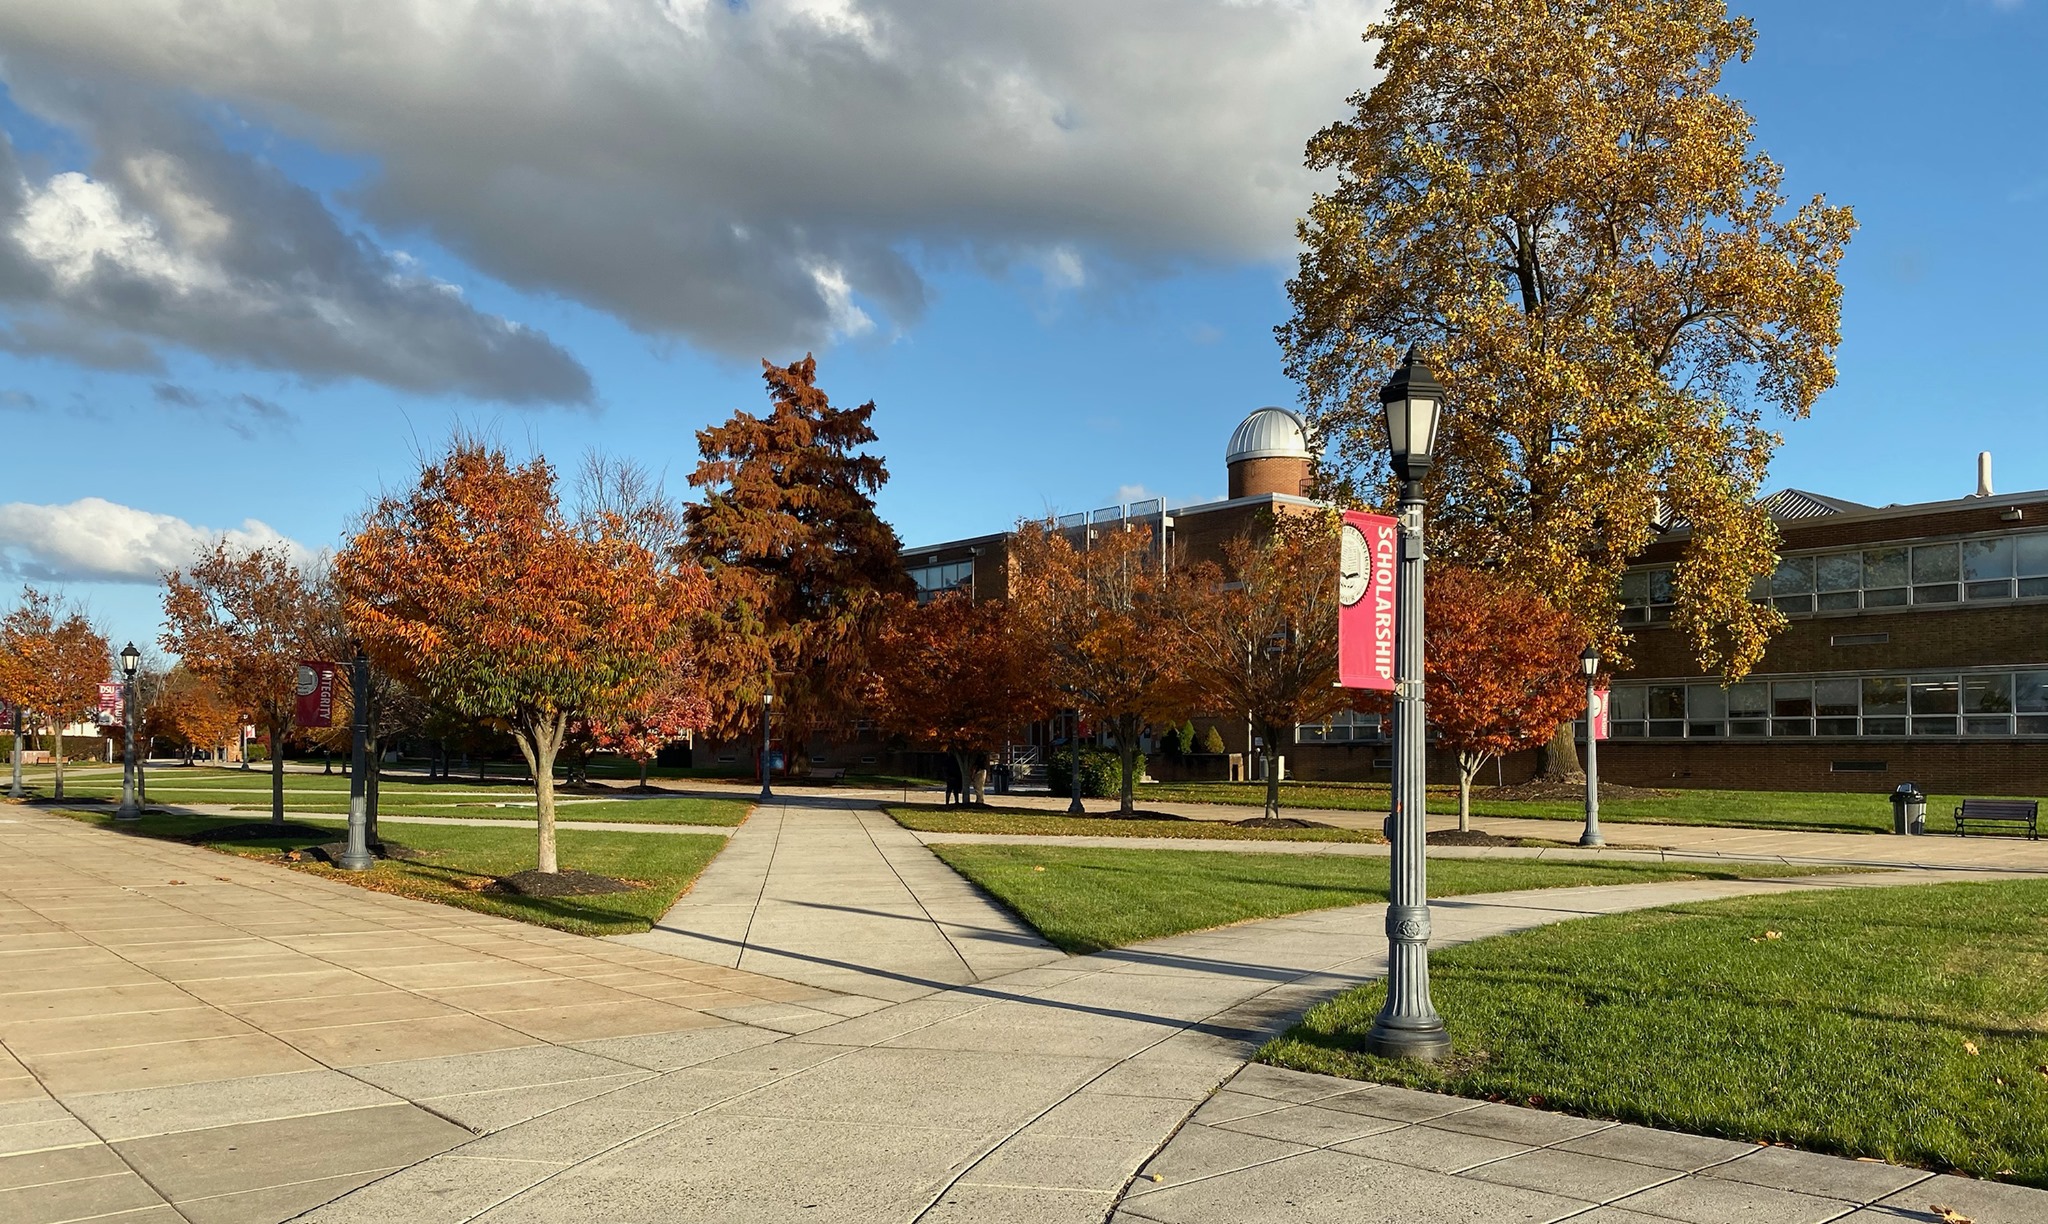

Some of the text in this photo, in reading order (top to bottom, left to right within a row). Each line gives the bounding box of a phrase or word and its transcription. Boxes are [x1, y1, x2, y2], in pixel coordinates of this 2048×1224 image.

[1375, 526, 1393, 680] SCHOLARSHIP
[100, 685, 115, 694] DSU
[320, 670, 333, 719] INTEGRITY
